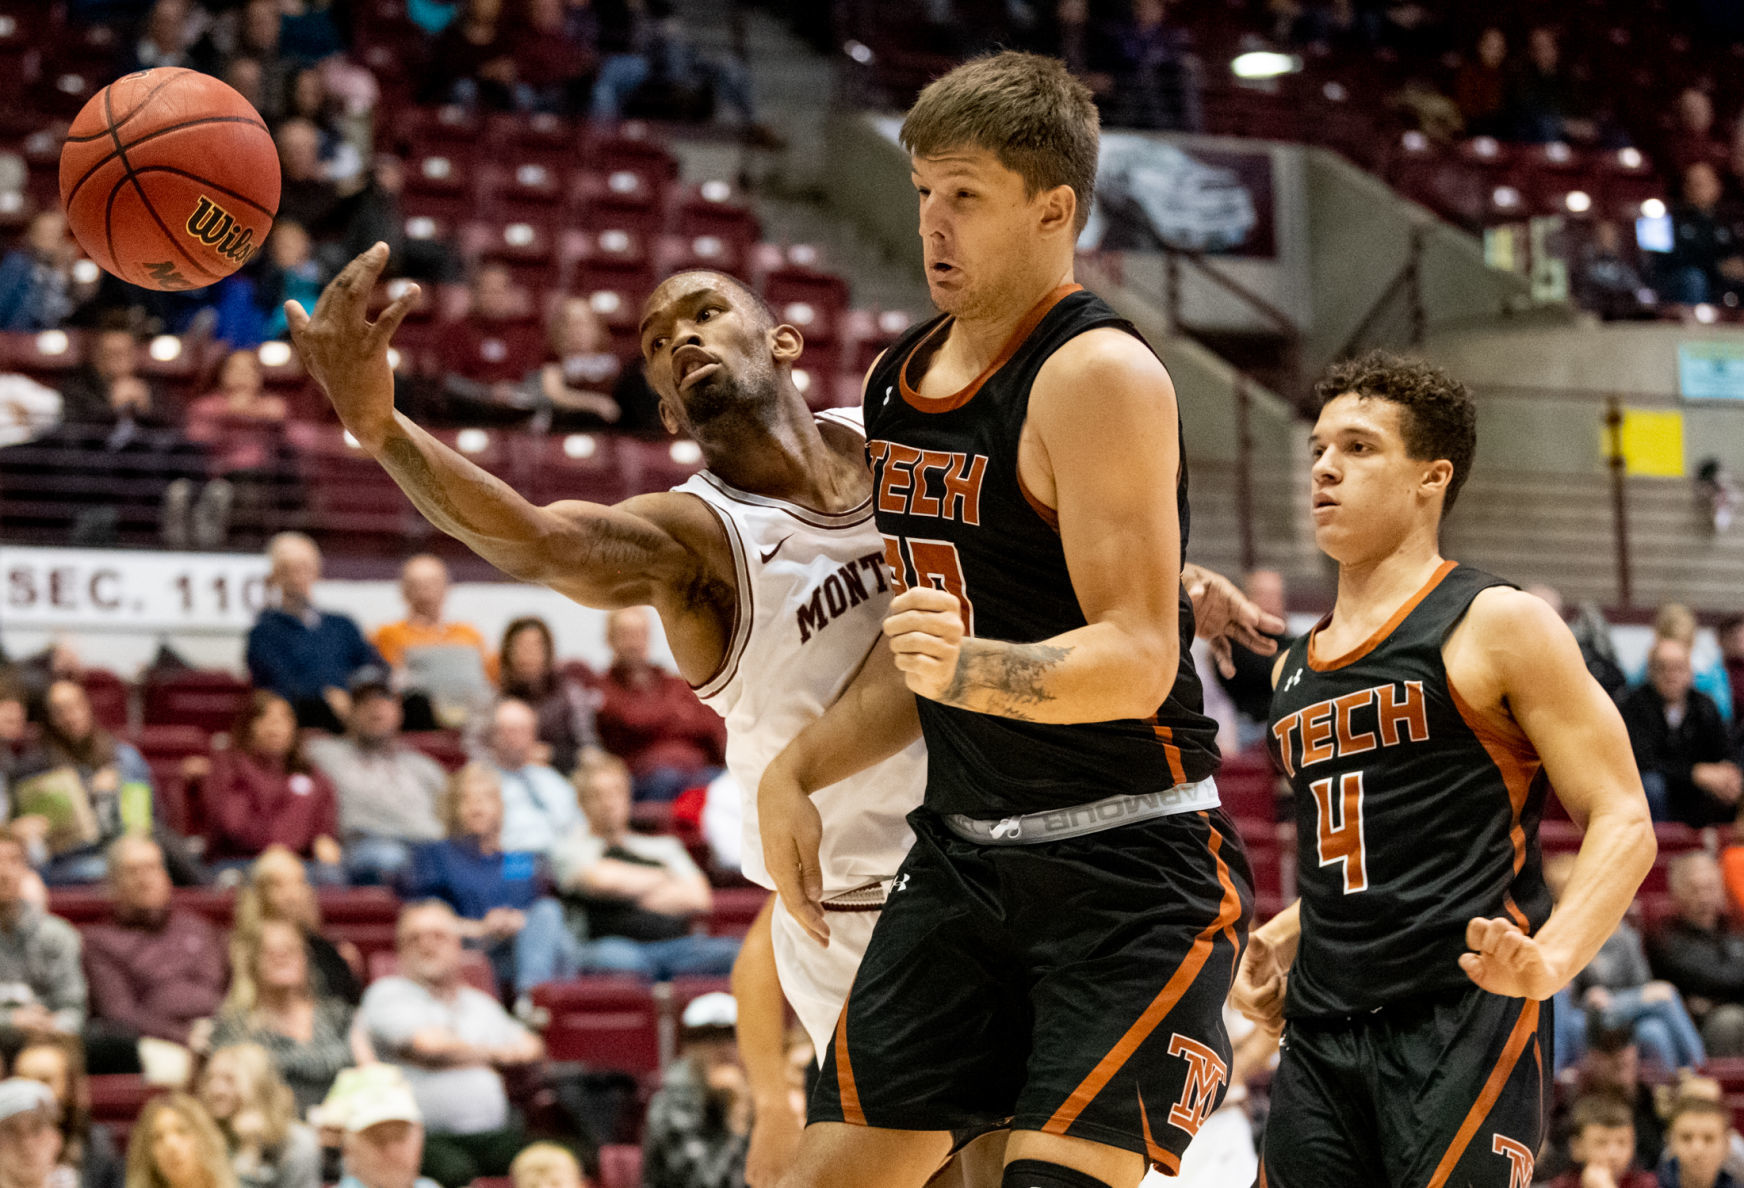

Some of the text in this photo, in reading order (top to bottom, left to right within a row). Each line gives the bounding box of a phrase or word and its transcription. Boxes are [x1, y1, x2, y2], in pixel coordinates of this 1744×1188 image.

[866, 439, 989, 526] TECH
[8, 565, 146, 612] SEC.
[1272, 680, 1430, 779] TECH
[1309, 770, 1368, 895] 4
